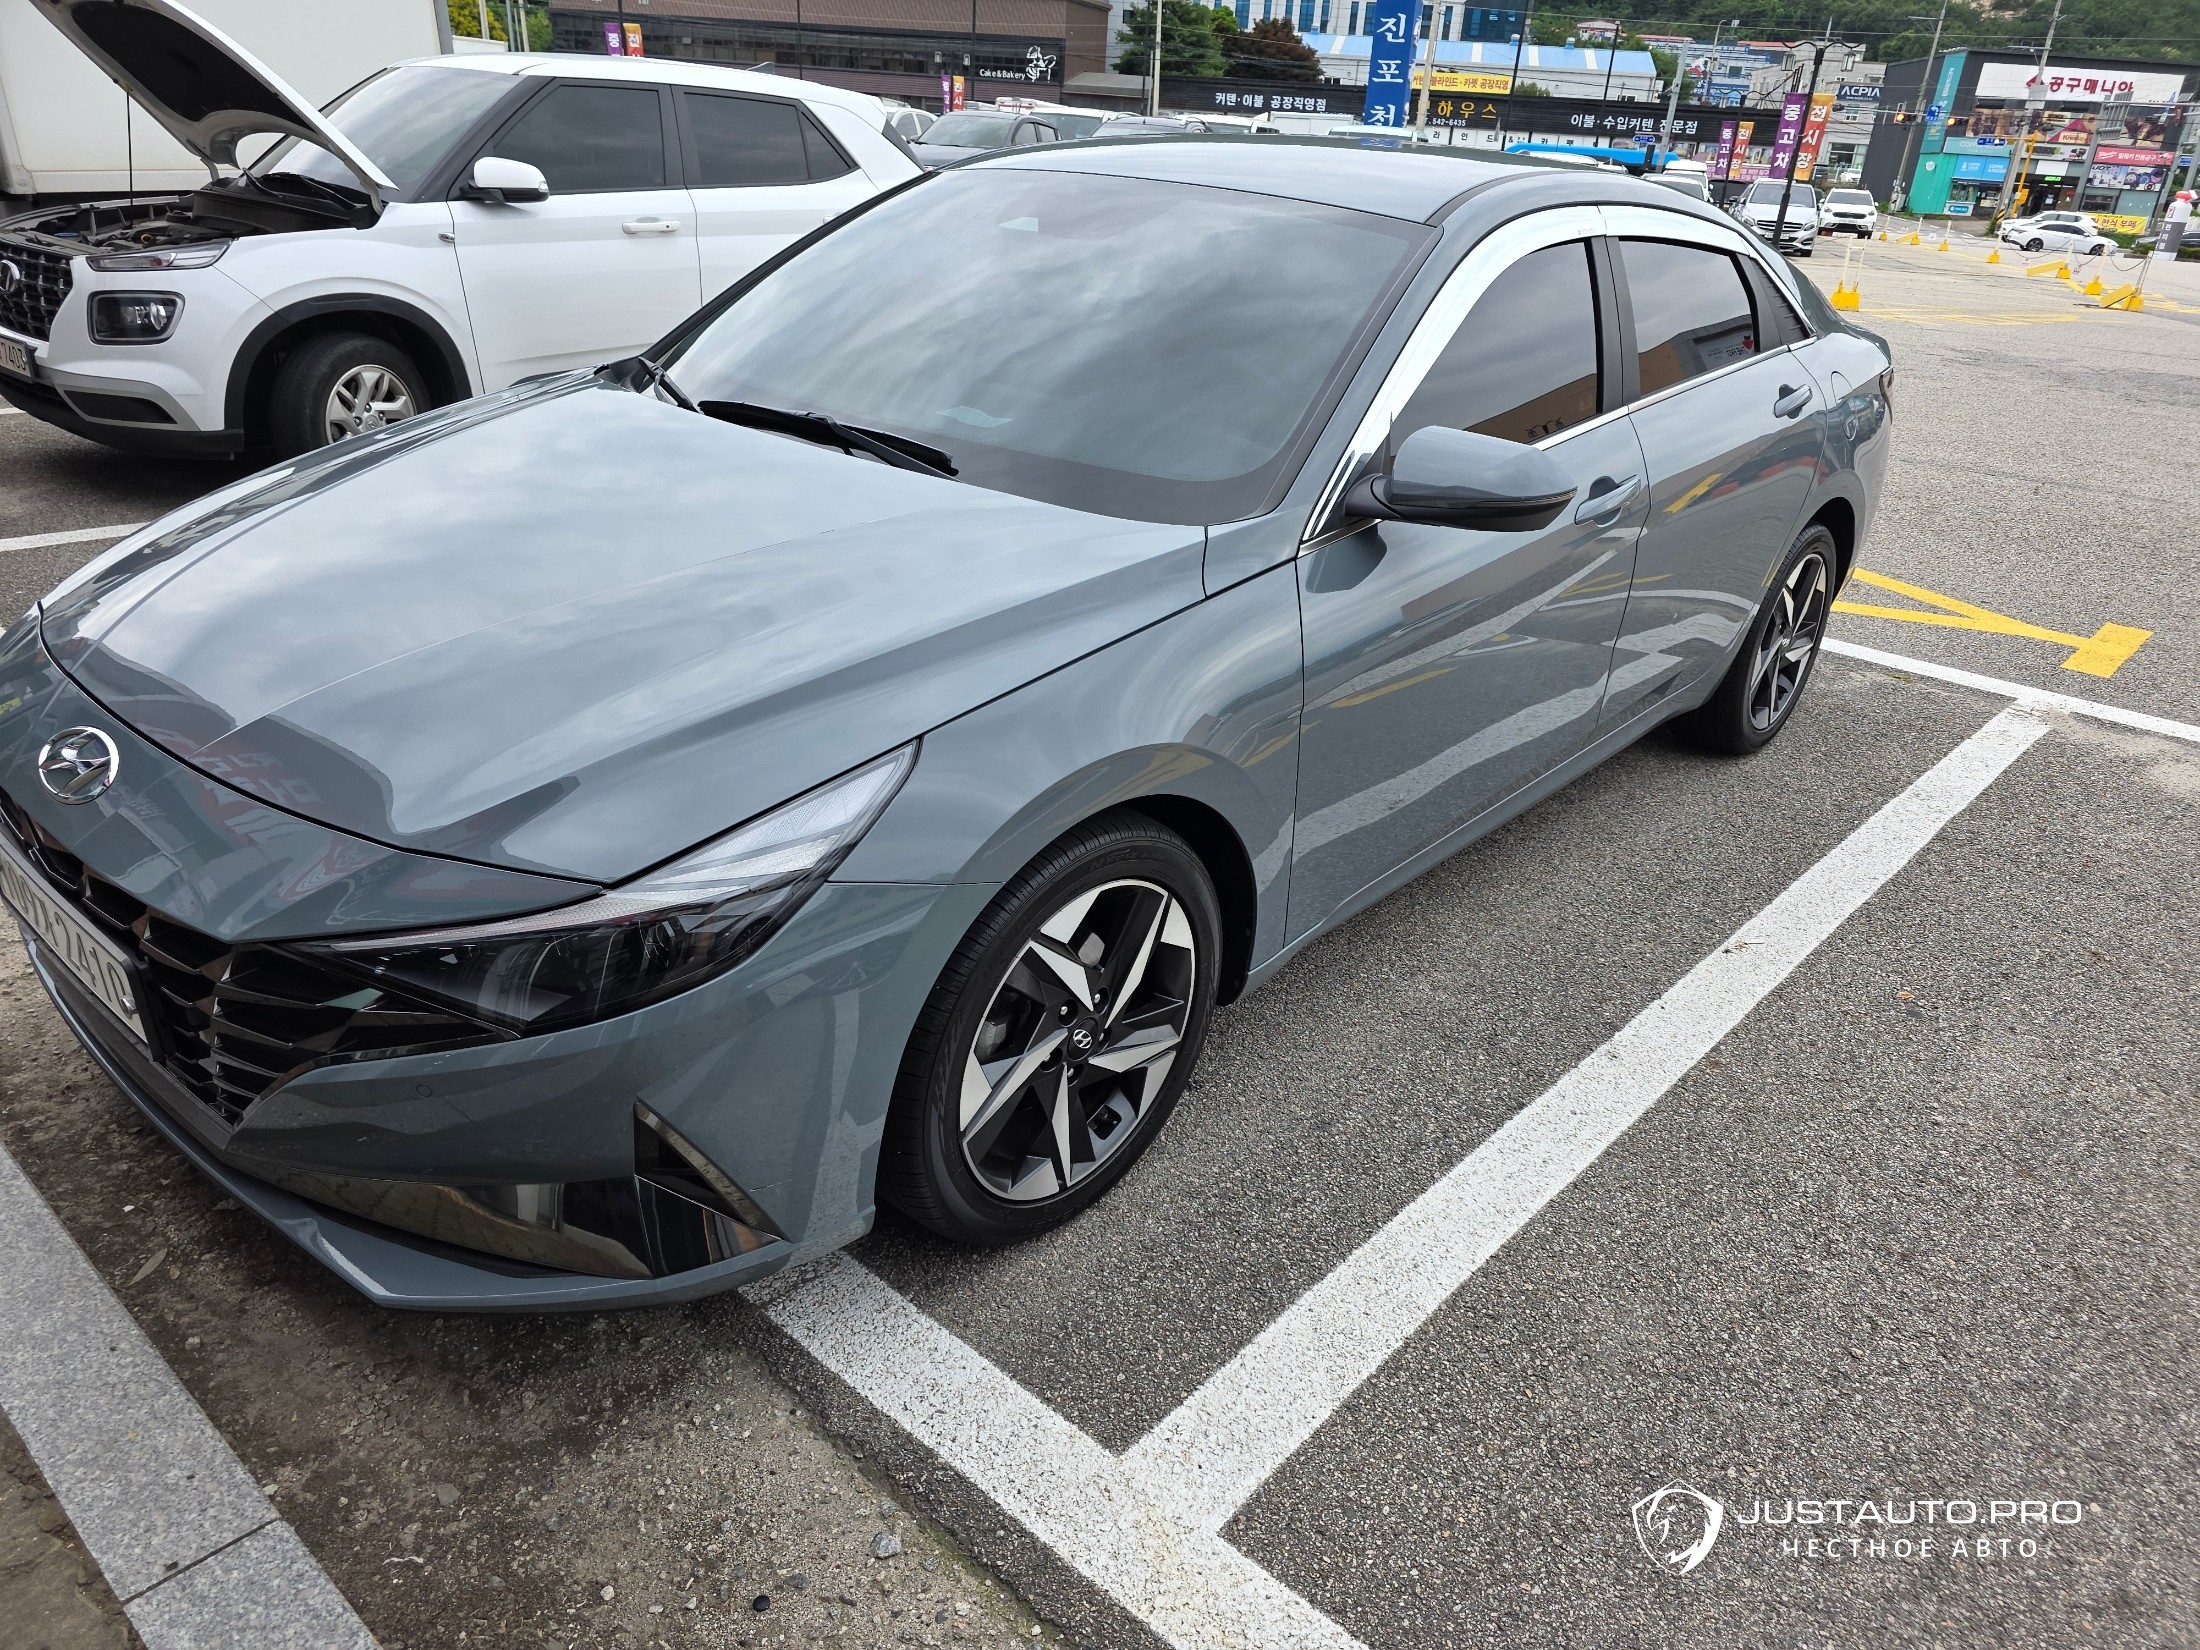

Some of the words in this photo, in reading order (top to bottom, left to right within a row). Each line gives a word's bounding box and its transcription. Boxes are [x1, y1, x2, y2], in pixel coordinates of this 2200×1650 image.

[1270, 95, 1327, 112] 공장직영점
[1841, 85, 1880, 98] ACPIA
[2049, 76, 2134, 95] 공구매니아
[1717, 128, 1733, 169] 중고차
[1731, 129, 1750, 169] 전시장
[1773, 104, 1801, 169] 중고차
[1796, 105, 1828, 169] 전시장
[54, 911, 133, 1021] 2410
